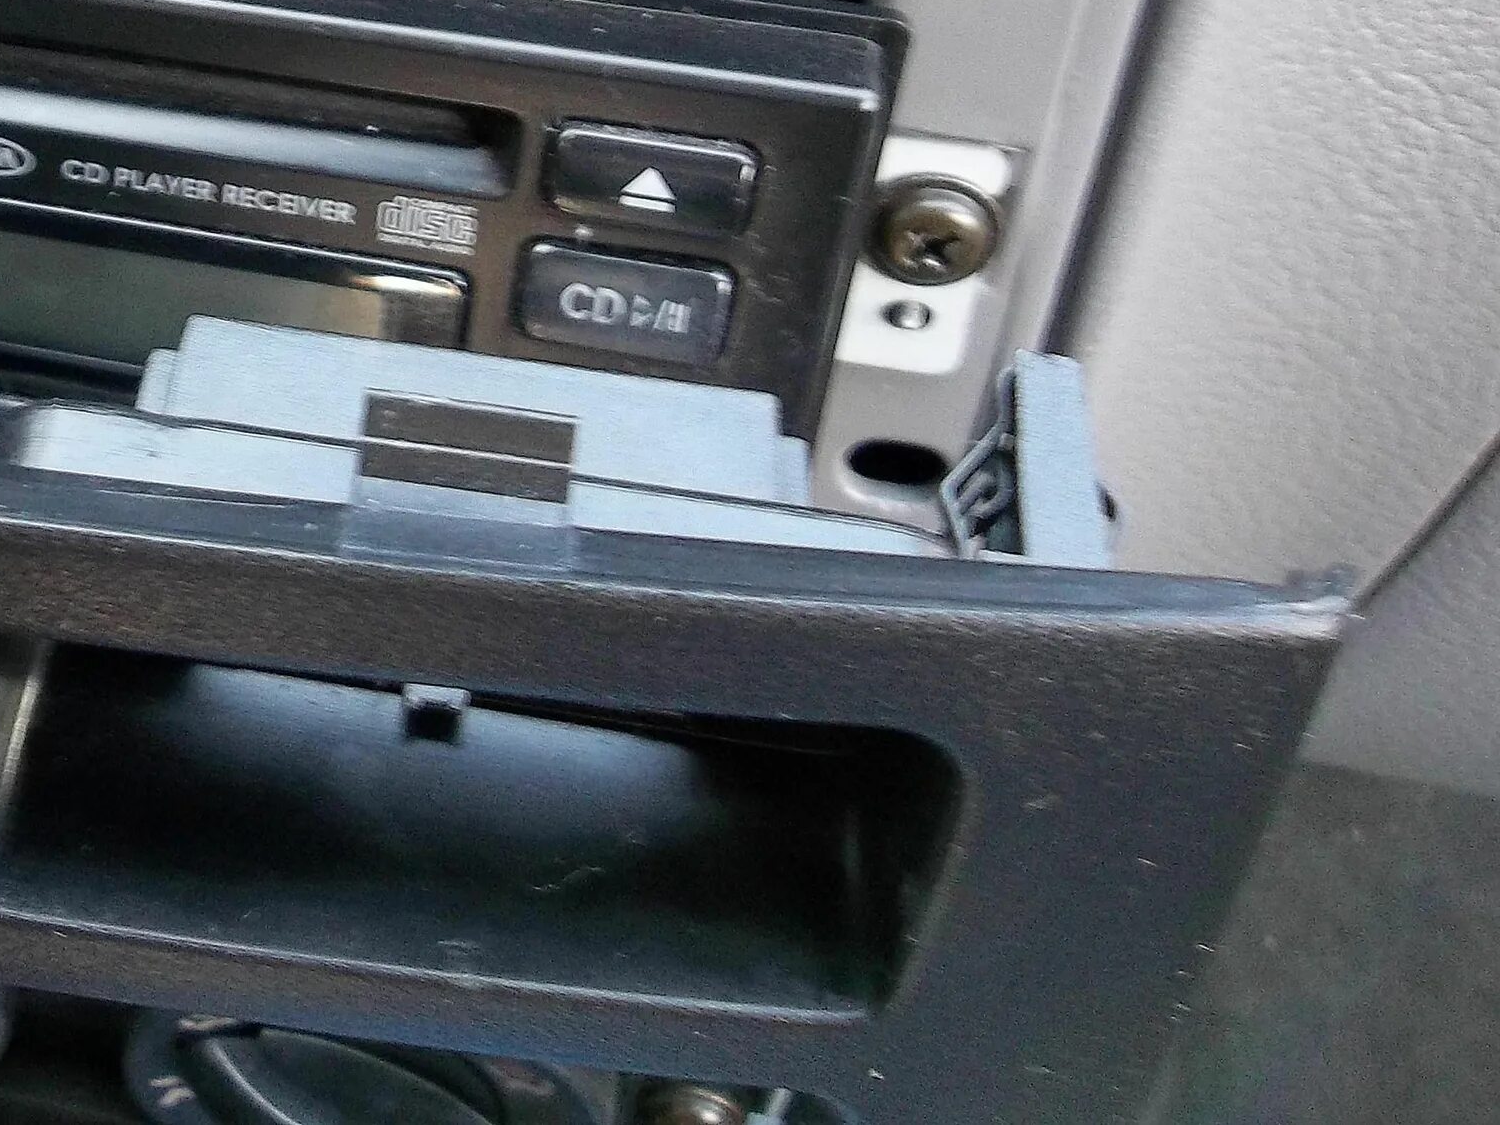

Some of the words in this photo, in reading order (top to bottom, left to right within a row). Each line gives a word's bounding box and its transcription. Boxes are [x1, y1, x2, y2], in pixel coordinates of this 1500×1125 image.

[60, 158, 111, 185] CD
[113, 165, 220, 204] PLAYER
[221, 182, 358, 226] RECEIVER
